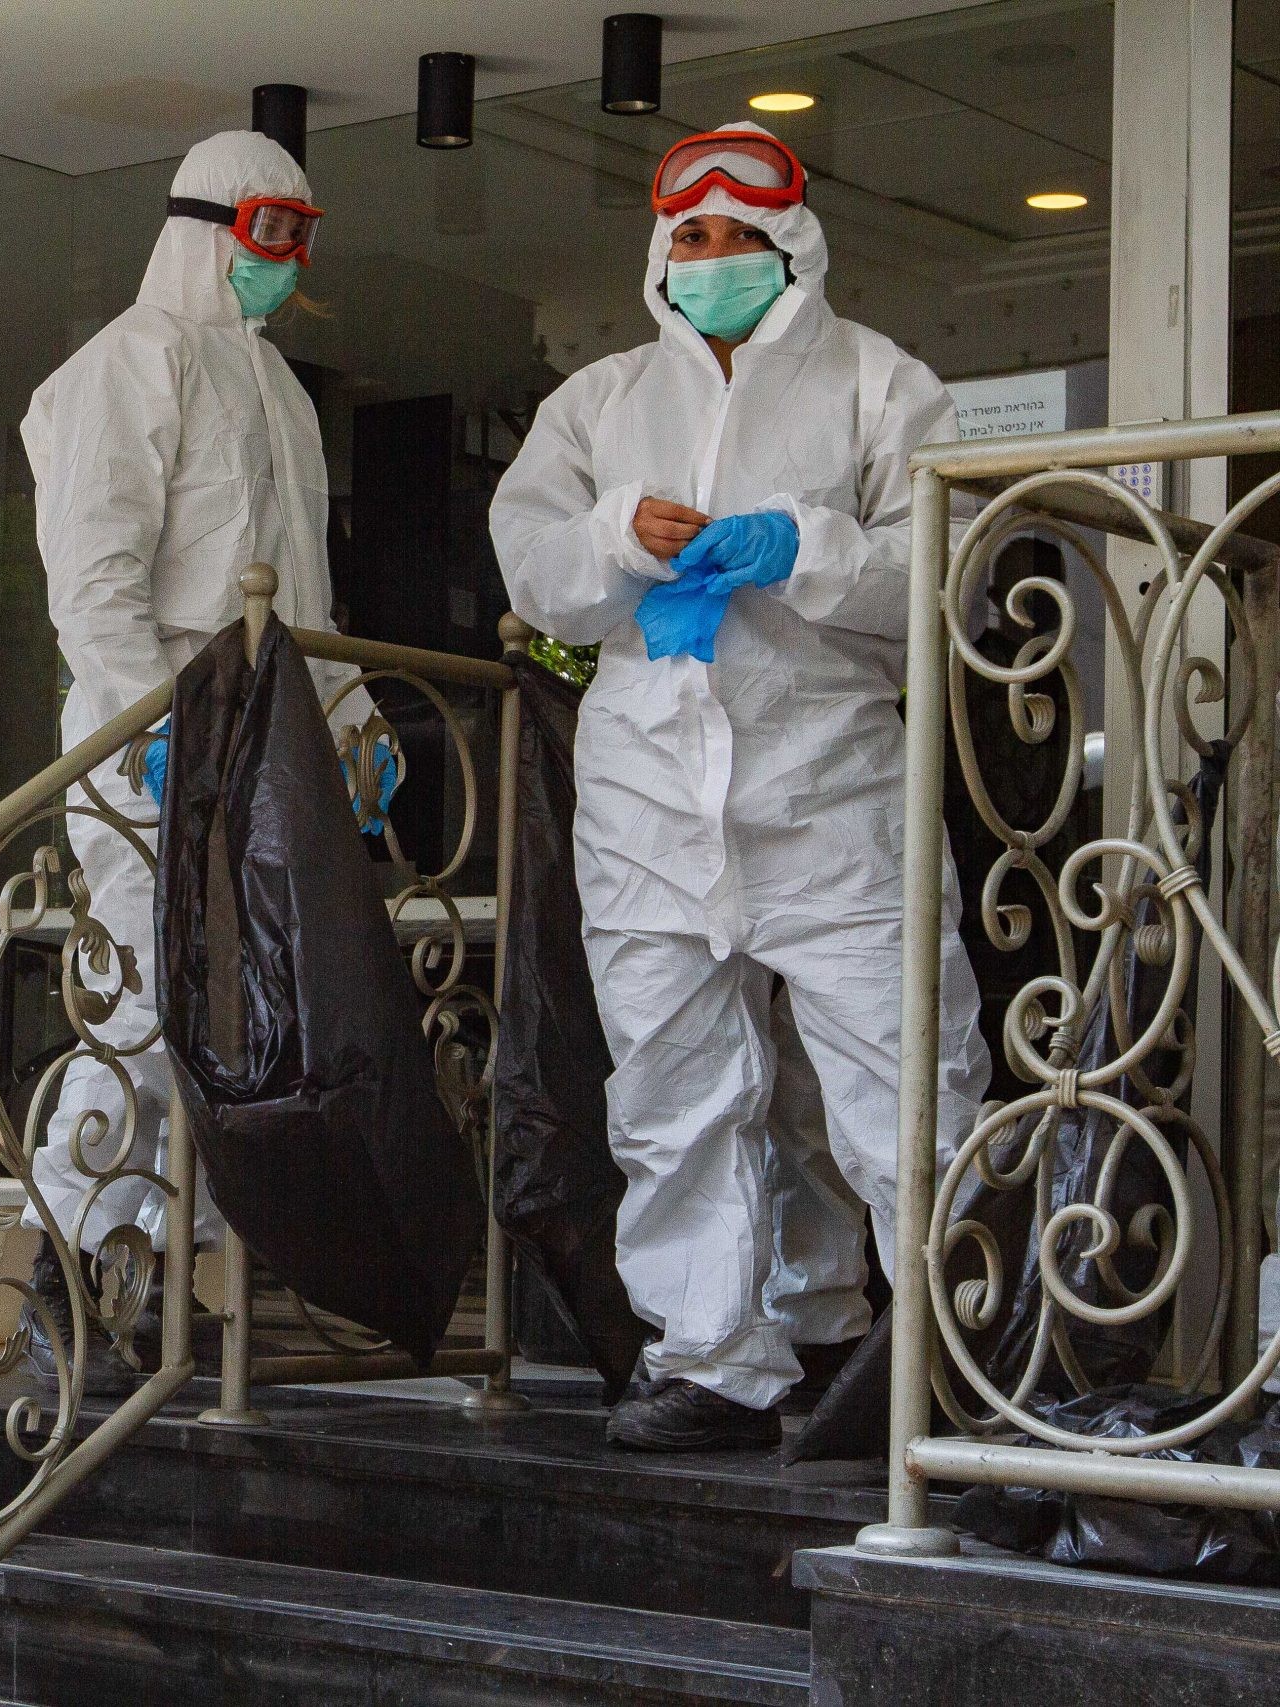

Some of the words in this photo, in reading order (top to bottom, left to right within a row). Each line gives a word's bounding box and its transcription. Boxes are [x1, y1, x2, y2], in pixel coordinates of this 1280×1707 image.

[972, 406, 1001, 417] משרד
[1005, 401, 1045, 413] בהוראת
[969, 424, 994, 437] לבית
[998, 422, 1026, 433] כניסה
[1030, 420, 1044, 432] אין
